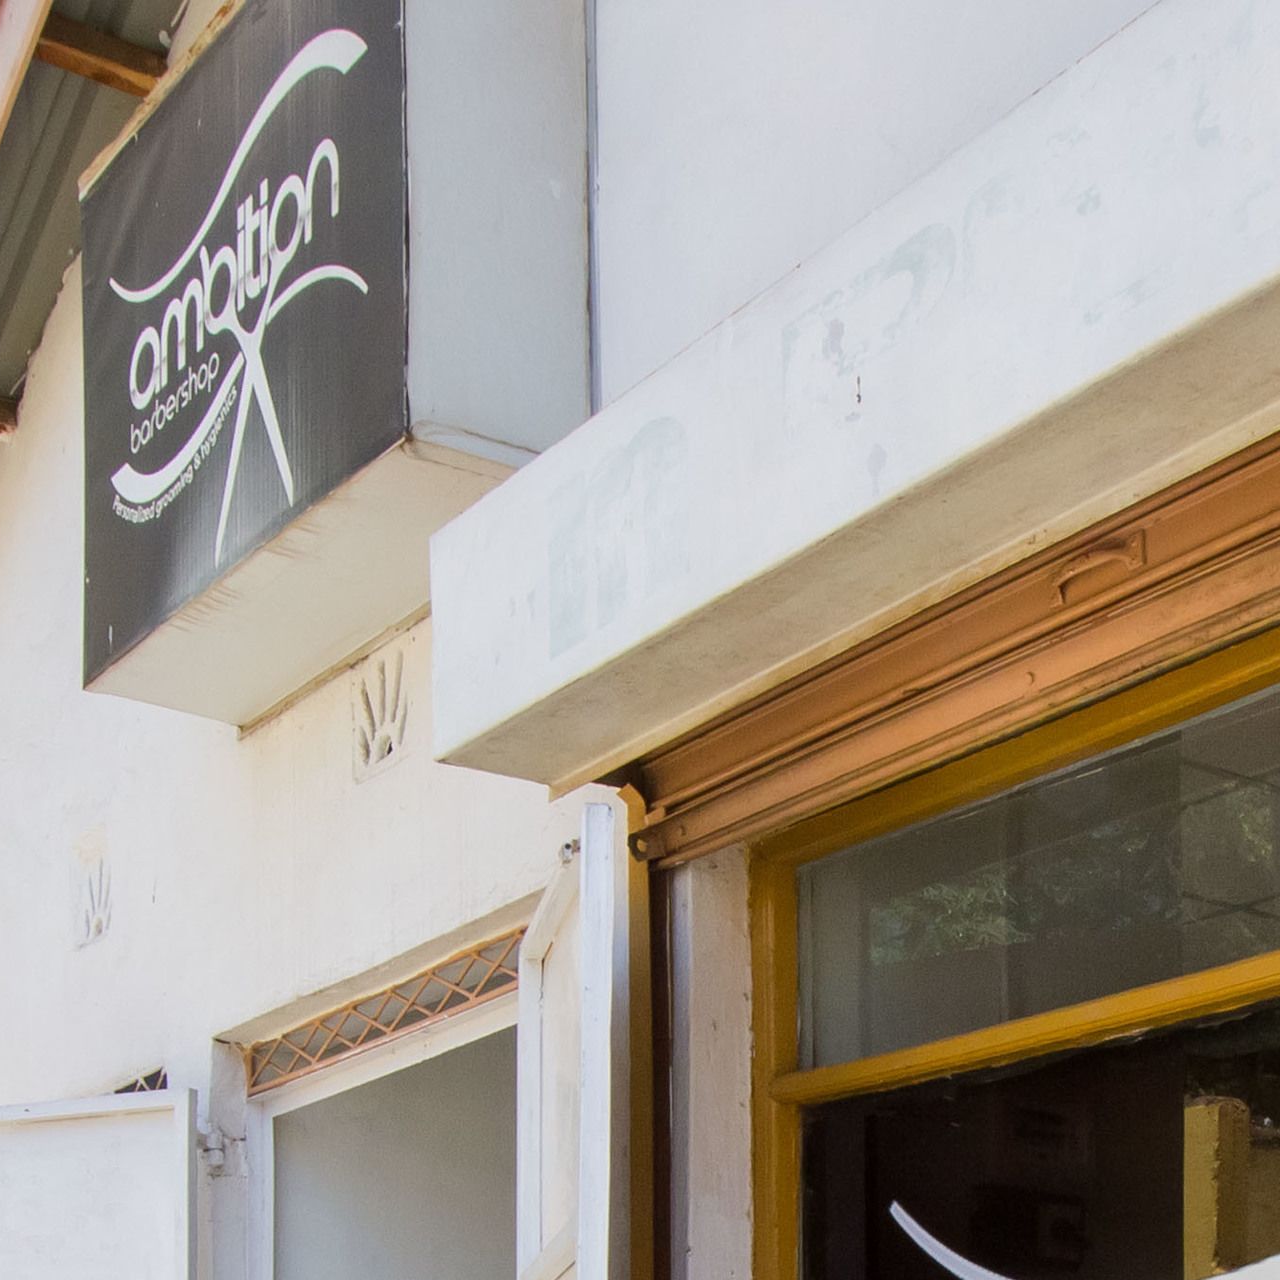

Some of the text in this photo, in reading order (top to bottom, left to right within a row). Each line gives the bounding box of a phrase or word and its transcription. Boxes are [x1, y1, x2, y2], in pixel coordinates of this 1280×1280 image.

[129, 138, 340, 411] ambition
[130, 352, 220, 454] barbershop
[154, 464, 194, 519] grooming
[193, 453, 202, 471] &
